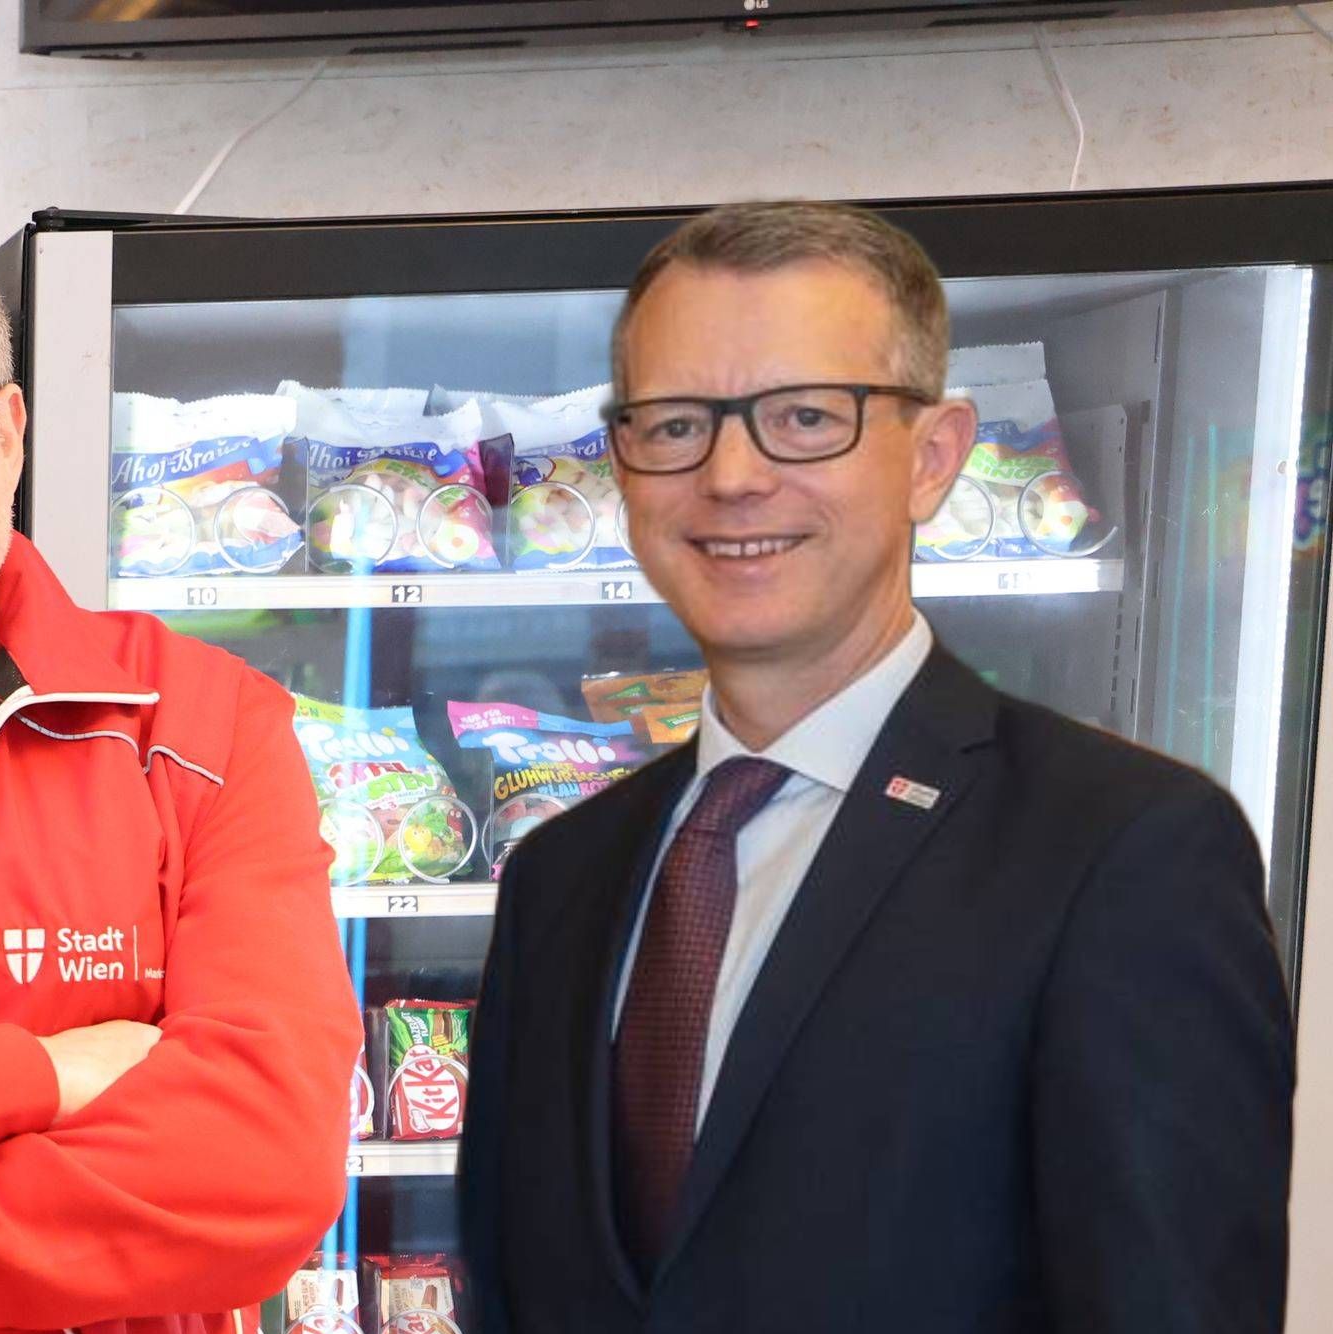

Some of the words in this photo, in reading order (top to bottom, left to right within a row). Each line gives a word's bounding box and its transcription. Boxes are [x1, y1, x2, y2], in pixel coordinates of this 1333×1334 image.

[190, 587, 217, 604] 10
[394, 585, 421, 602] 12
[604, 582, 632, 599] 14
[481, 731, 617, 765] Trolli
[389, 897, 418, 912] 22
[57, 925, 125, 953] Stadt
[57, 955, 124, 982] Wien
